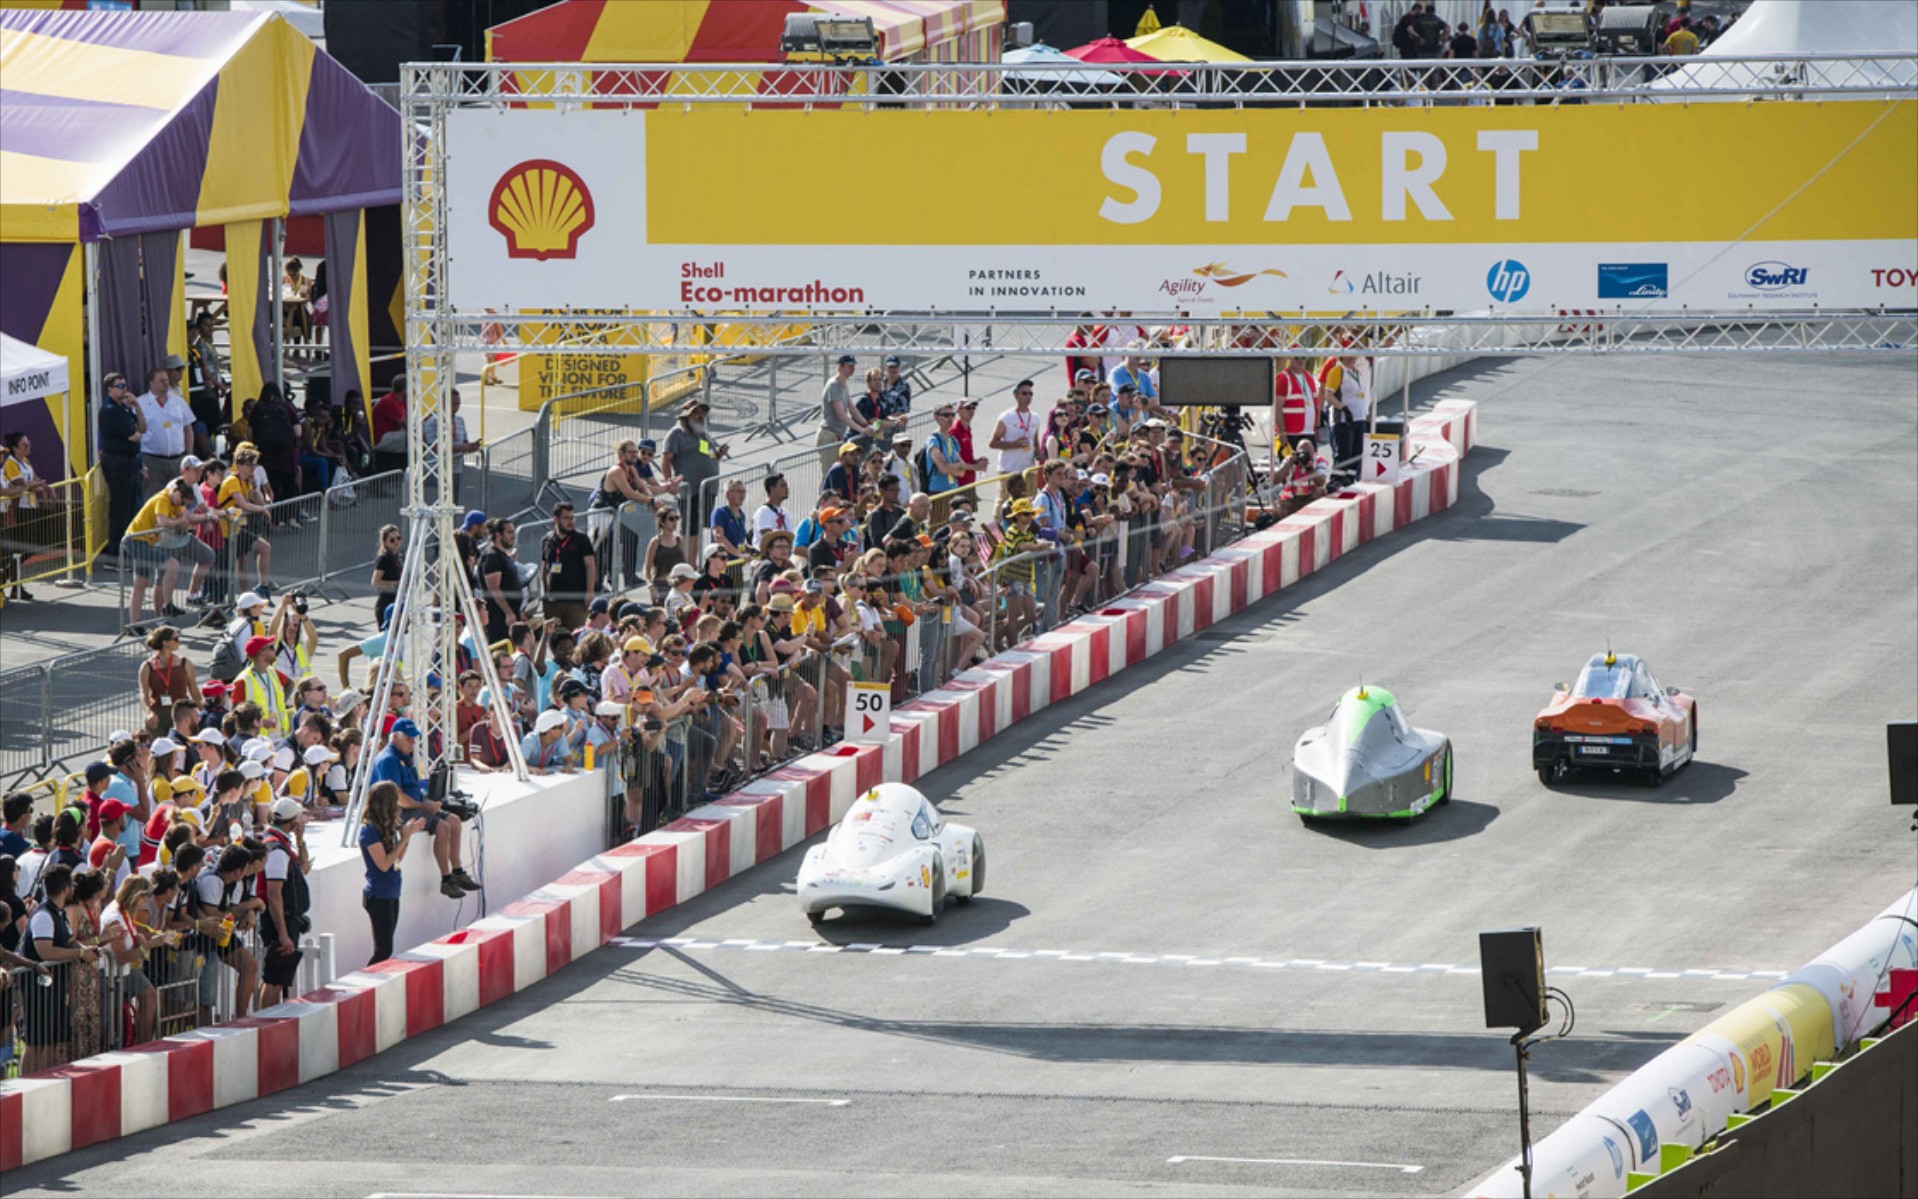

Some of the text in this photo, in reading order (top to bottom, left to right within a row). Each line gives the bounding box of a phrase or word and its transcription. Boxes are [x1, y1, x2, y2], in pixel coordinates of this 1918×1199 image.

[1098, 130, 1539, 224] START
[681, 262, 724, 278] Shell
[968, 270, 1041, 280] PARTNERS
[1750, 268, 1809, 285] SwRI
[1158, 278, 1206, 296] Agility
[1362, 271, 1421, 294] Altair
[1492, 259, 1527, 303] hp
[681, 279, 864, 303] Eco-marathon
[968, 286, 1086, 296] IN INNOVATION
[8, 371, 50, 396] INFO POINT
[597, 373, 628, 386] FOR
[1371, 442, 1392, 458] 25
[856, 693, 883, 711] 50
